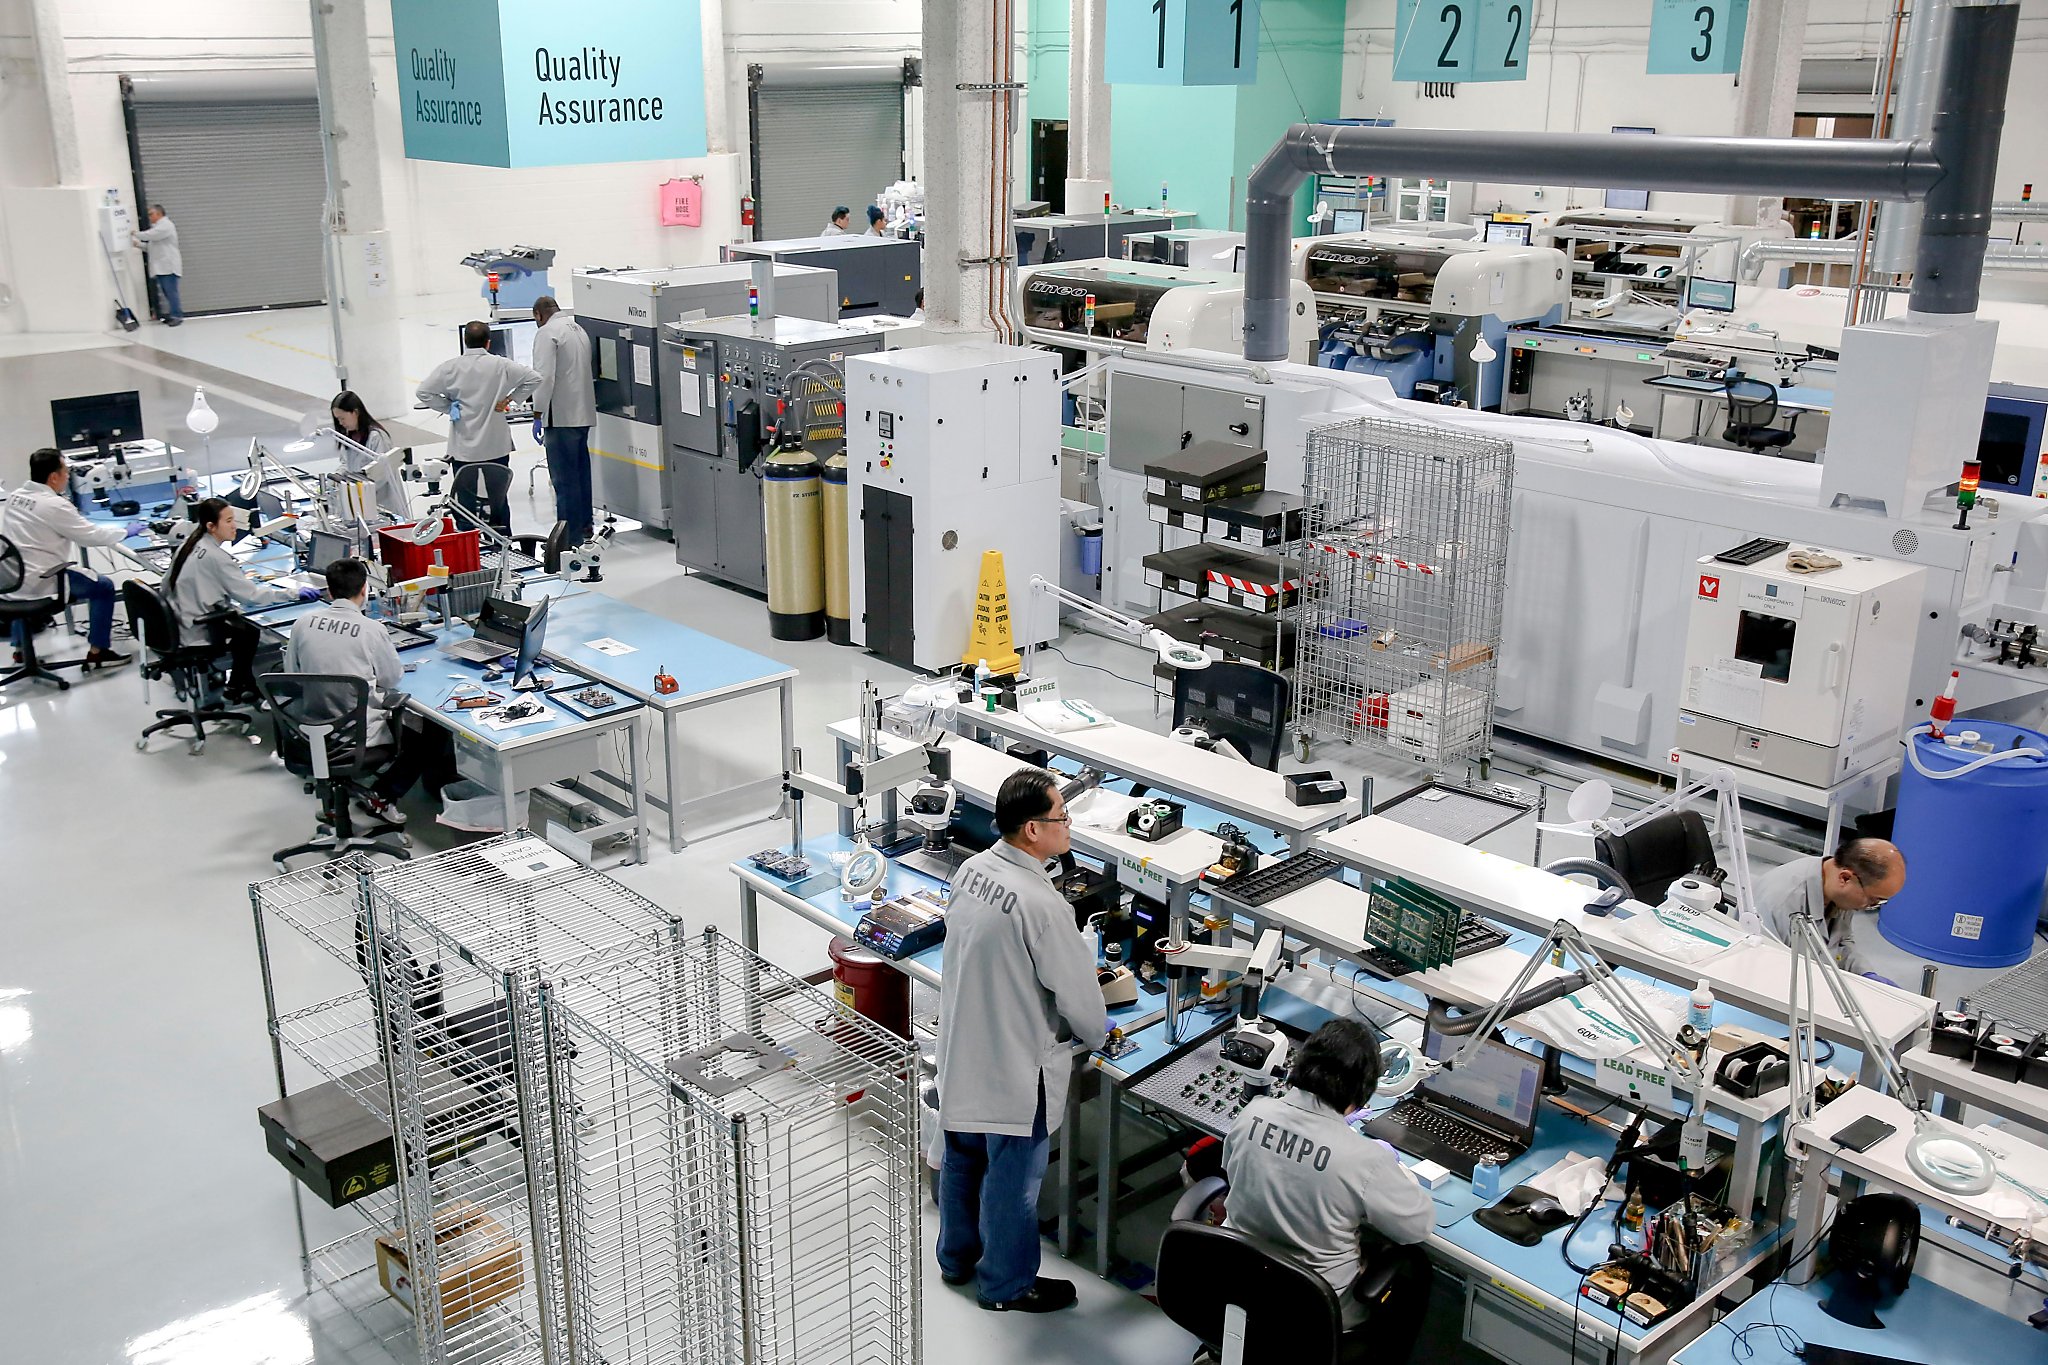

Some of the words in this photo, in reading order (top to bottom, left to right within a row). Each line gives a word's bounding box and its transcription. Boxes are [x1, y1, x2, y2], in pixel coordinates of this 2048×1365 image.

[1153, 0, 1166, 68] 1
[1230, 0, 1242, 68] 1
[1437, 4, 1461, 67] 2
[1504, 5, 1522, 67] 2
[1691, 6, 1714, 62] 3
[411, 48, 456, 89] Quality
[535, 47, 621, 87] Quality
[416, 90, 482, 125] Assurance
[538, 92, 663, 125] Assurance
[628, 306, 647, 318] Nikon
[1748, 593, 1763, 601] BAKING
[1764, 596, 1794, 606] COMPONENTS
[309, 616, 360, 637] TEMPO
[1020, 687, 1038, 697] LEAD
[1039, 682, 1056, 692] FREE
[495, 848, 552, 866] SHIPPING
[501, 846, 532, 857] CART
[1123, 857, 1141, 873] LEAD
[1143, 868, 1162, 883] FREE
[960, 867, 1017, 914] TEMPO
[1603, 1058, 1633, 1075] LEAD
[1636, 1069, 1665, 1086] FREE
[1248, 1116, 1331, 1171] TEMPO
